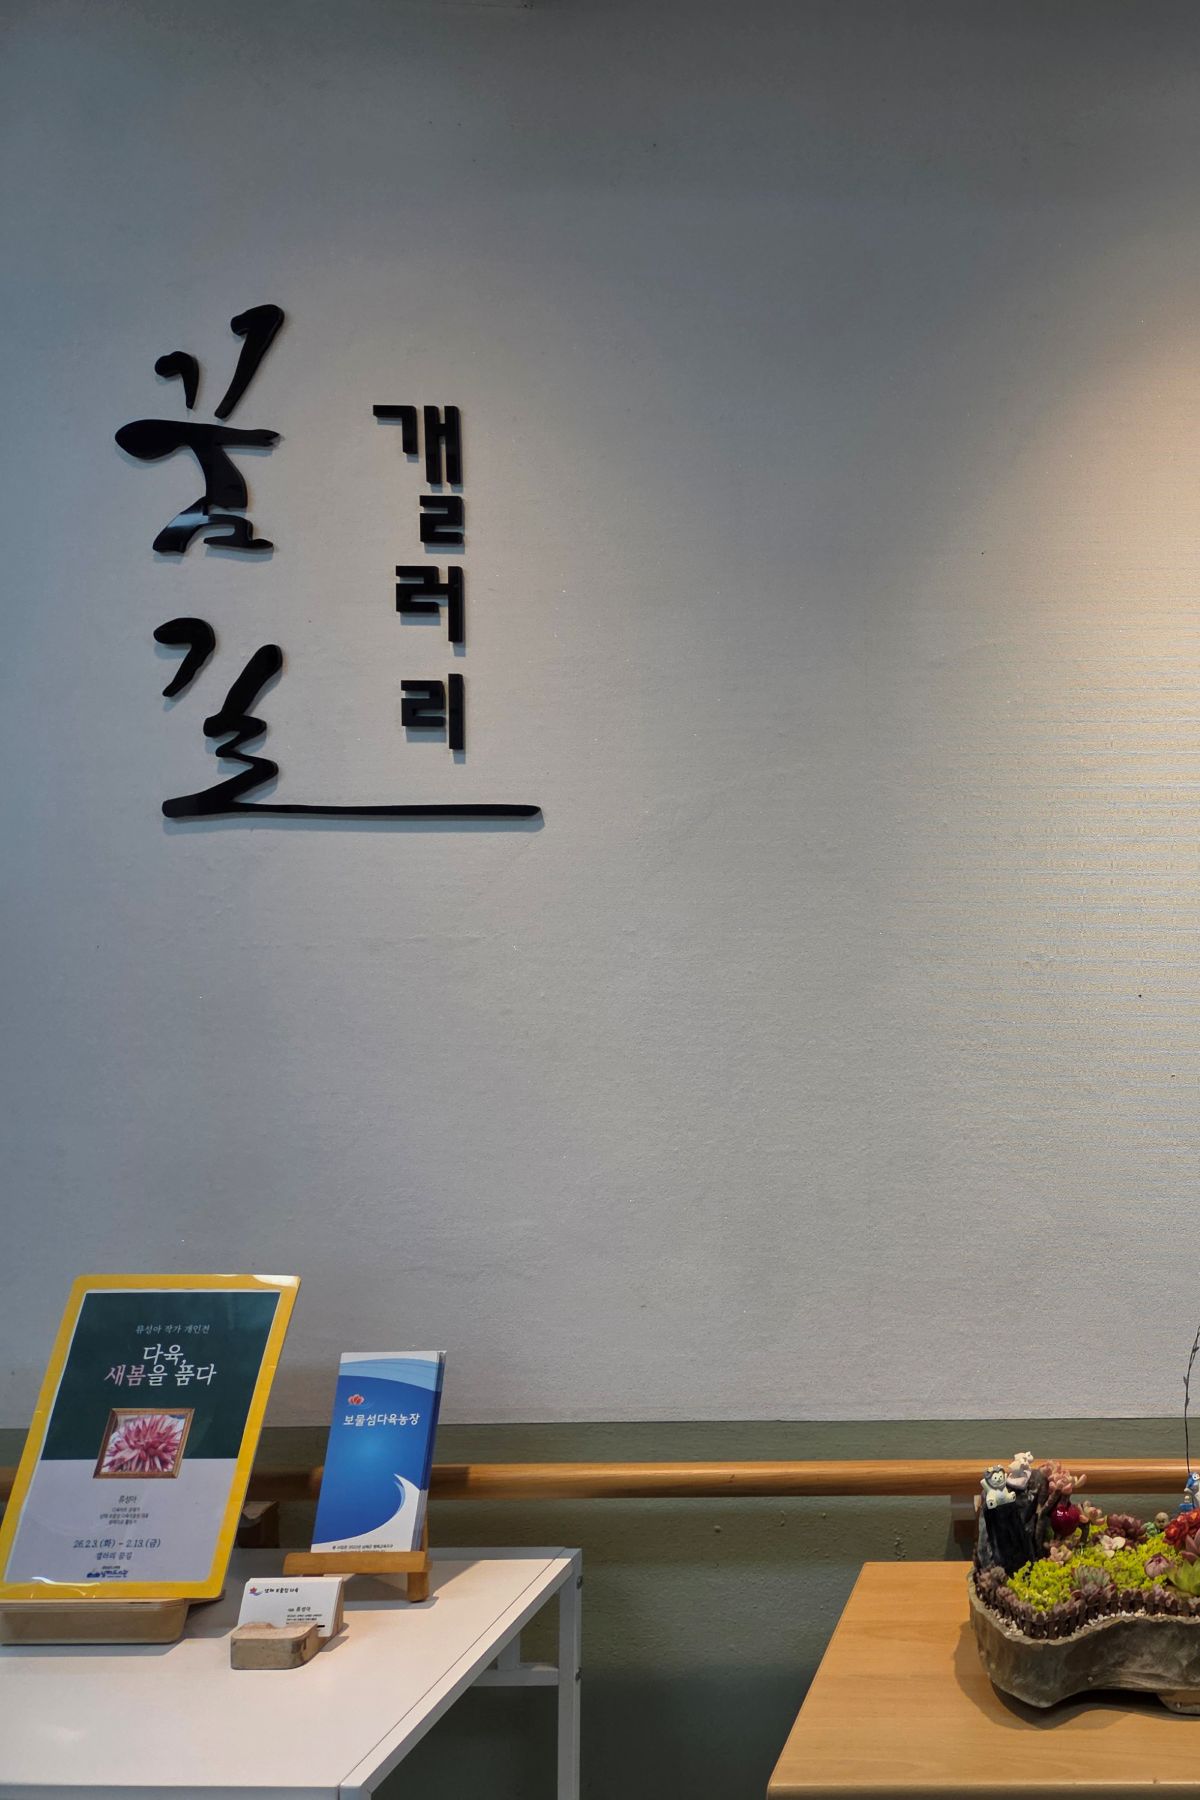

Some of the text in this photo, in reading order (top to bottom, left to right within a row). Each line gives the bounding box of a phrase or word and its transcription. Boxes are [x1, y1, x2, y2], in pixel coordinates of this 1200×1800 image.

[373, 405, 463, 750] 갤러리
[104, 1363, 218, 1387] 새봄을 품다
[343, 1412, 421, 1427] 보물섬다육농장
